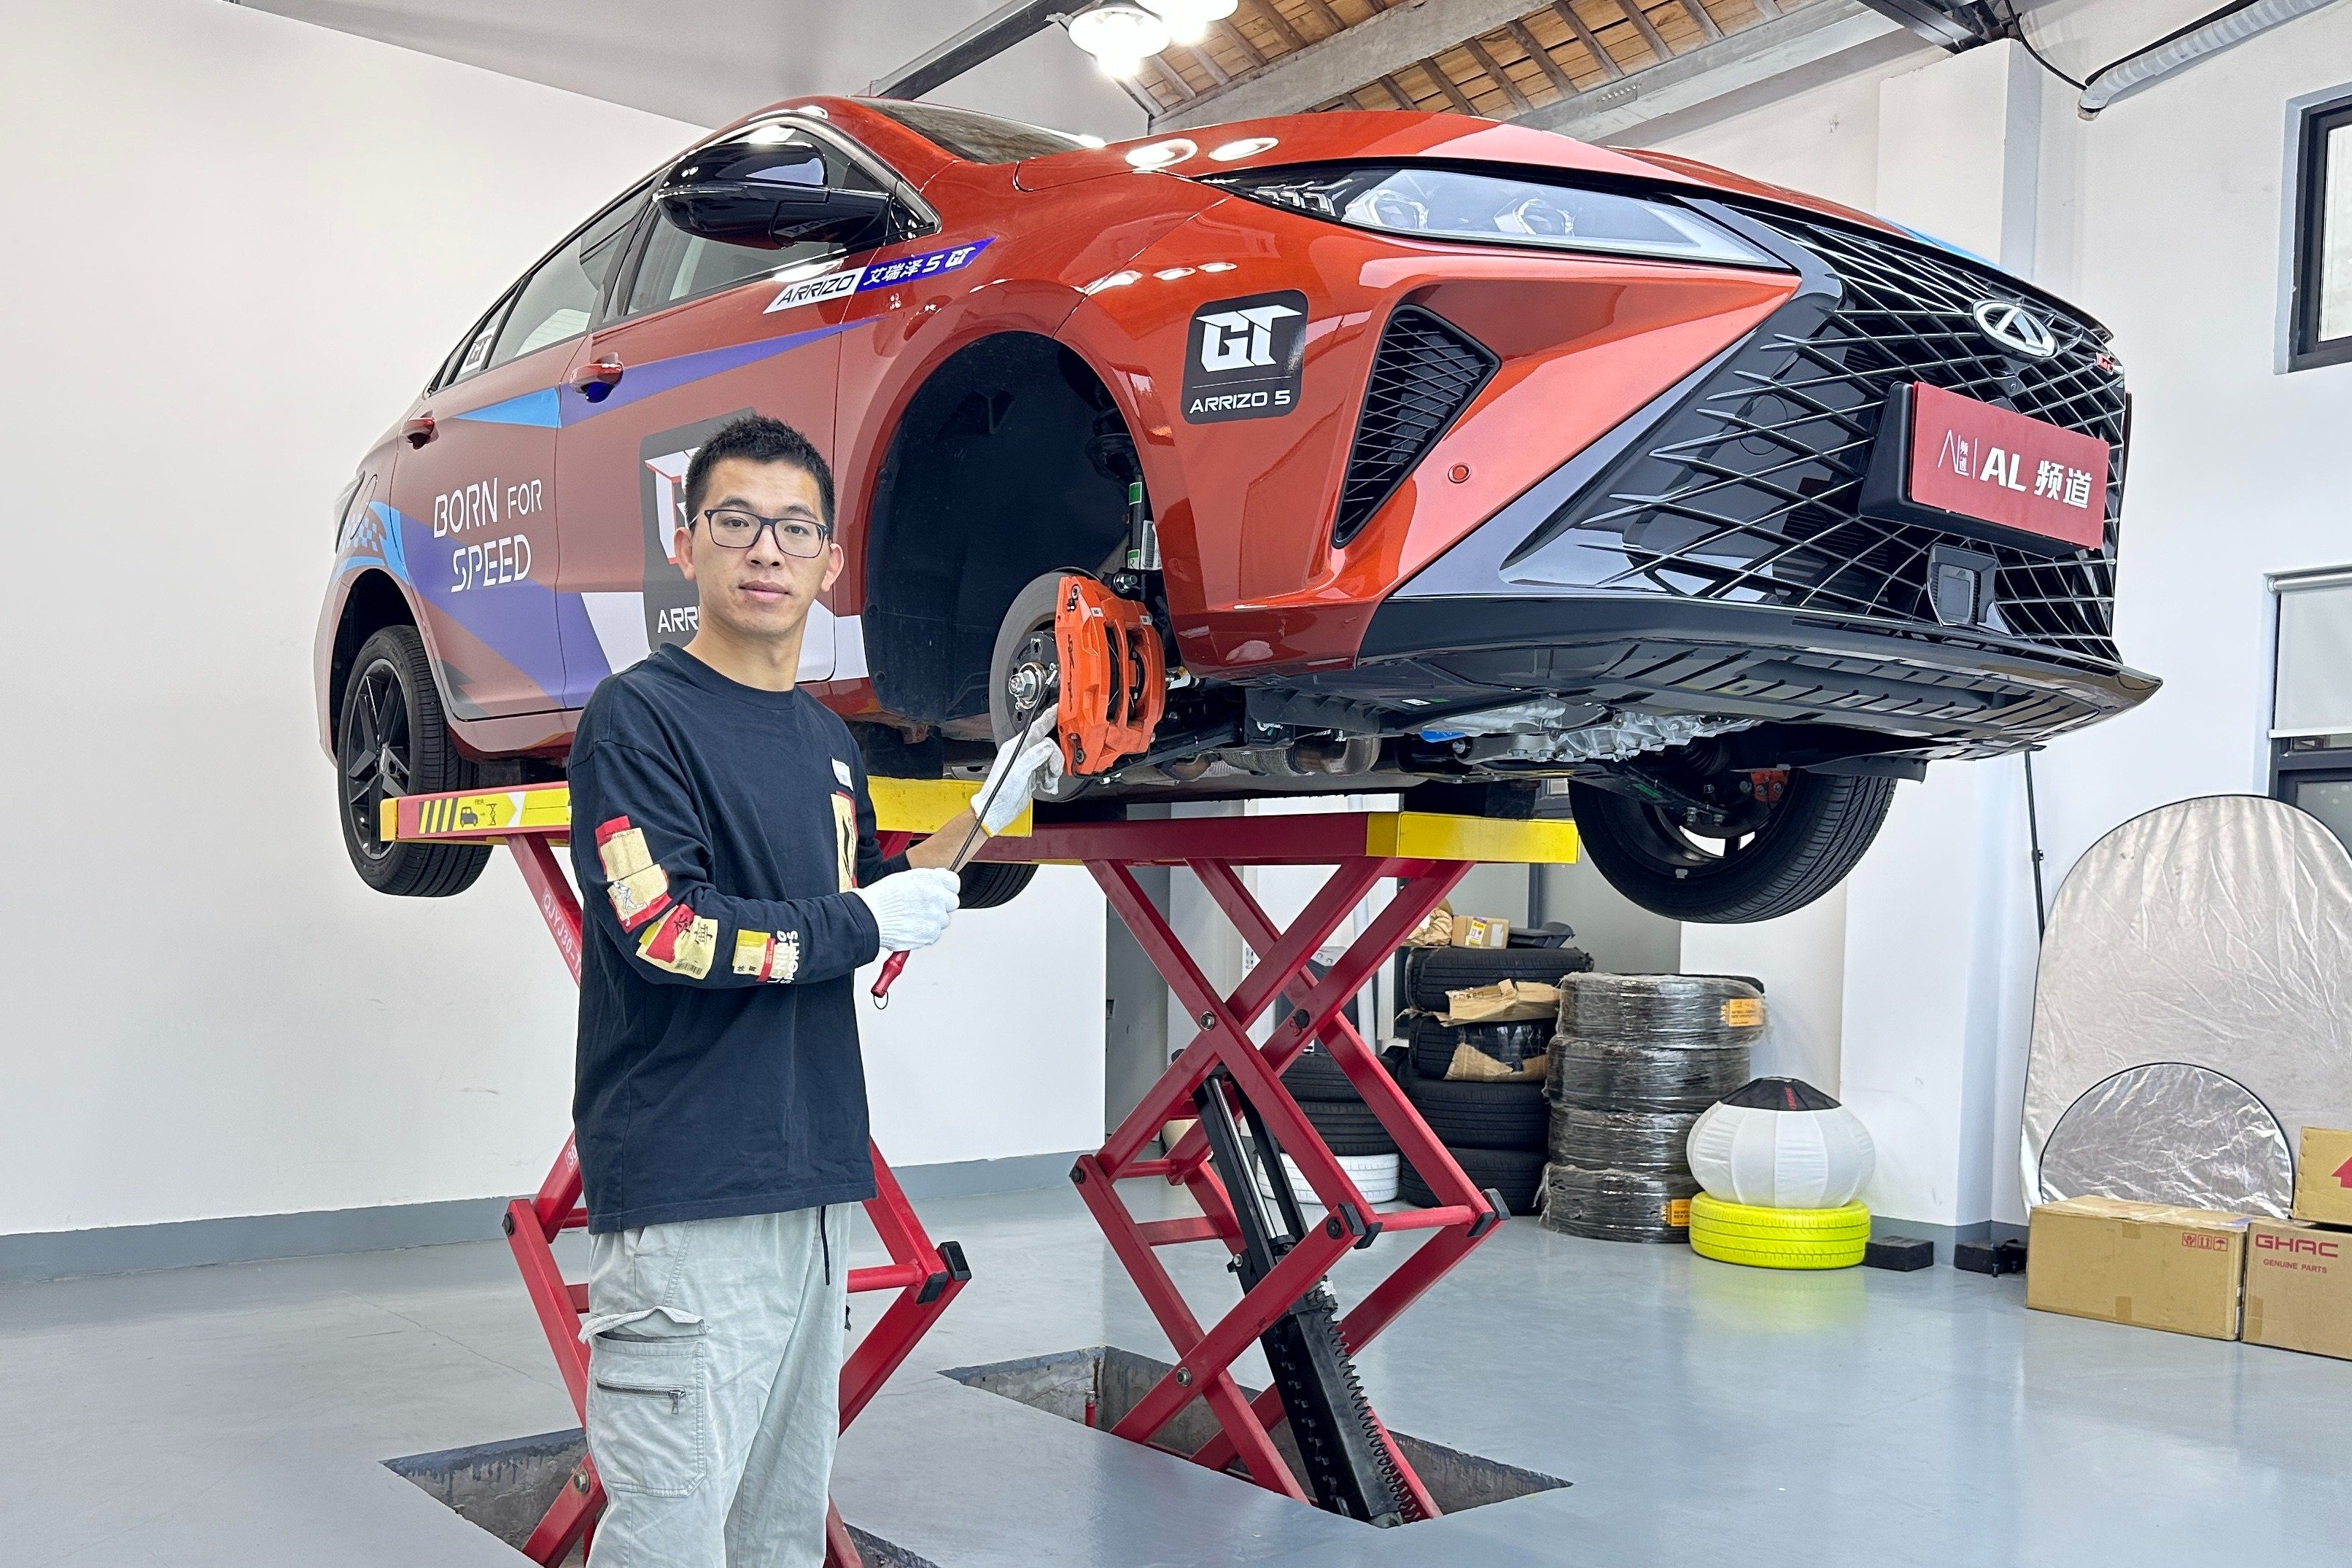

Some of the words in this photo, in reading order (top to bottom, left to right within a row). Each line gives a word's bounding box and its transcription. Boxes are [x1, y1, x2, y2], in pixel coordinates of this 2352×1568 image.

[777, 273, 857, 306] ARRIZO
[863, 260, 923, 287] 艾瑞泽
[923, 255, 945, 273] 5
[947, 246, 977, 269] GT
[1196, 304, 1303, 373] GT
[1189, 391, 1268, 414] ARRIZO
[1274, 389, 1291, 405] 5
[1979, 446, 2027, 492] AL
[2033, 459, 2093, 509] 频道
[433, 477, 498, 538] BORN
[508, 478, 543, 519] FOR
[450, 534, 532, 593] SPEED
[2255, 1233, 2339, 1258] GHAC
[2263, 1258, 2298, 1270] GENUINE
[2301, 1263, 2327, 1273] PARTS
